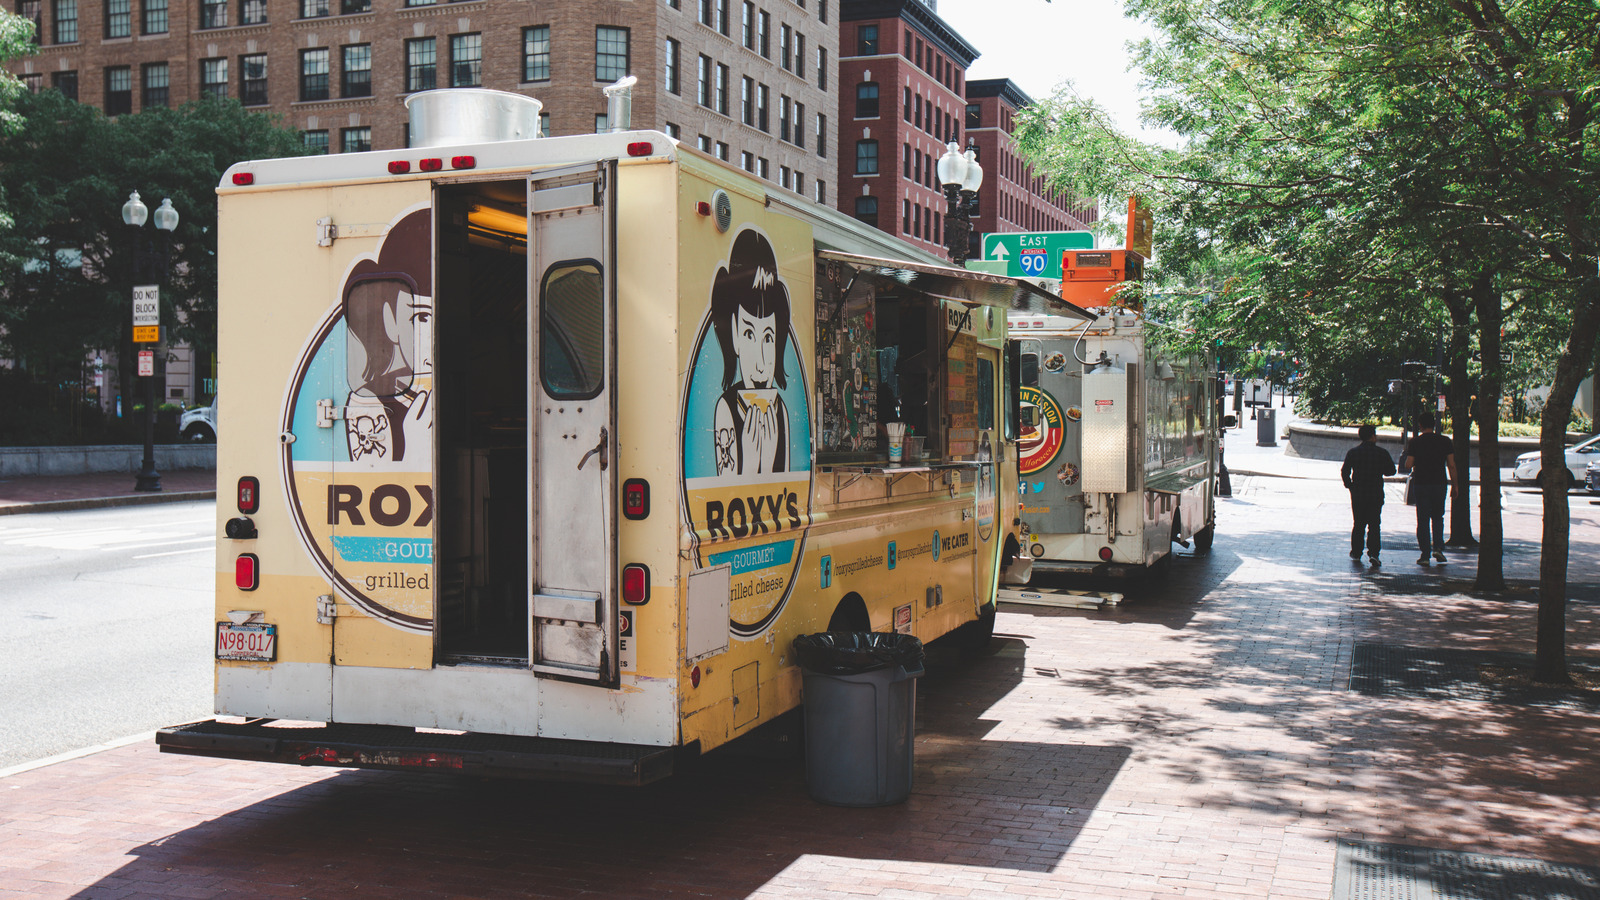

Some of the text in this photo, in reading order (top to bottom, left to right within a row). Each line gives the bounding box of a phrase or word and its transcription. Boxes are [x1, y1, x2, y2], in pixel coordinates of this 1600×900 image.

[1020, 235, 1048, 247] EAST
[1021, 255, 1045, 272] 90
[134, 290, 158, 300] DO NOT
[135, 303, 157, 313] BLOCK
[705, 487, 801, 543] ROXY'S
[941, 532, 969, 551] WE CATER
[733, 546, 775, 569] GOURMET
[365, 571, 430, 592] grilled
[730, 576, 784, 602] rilled cheese
